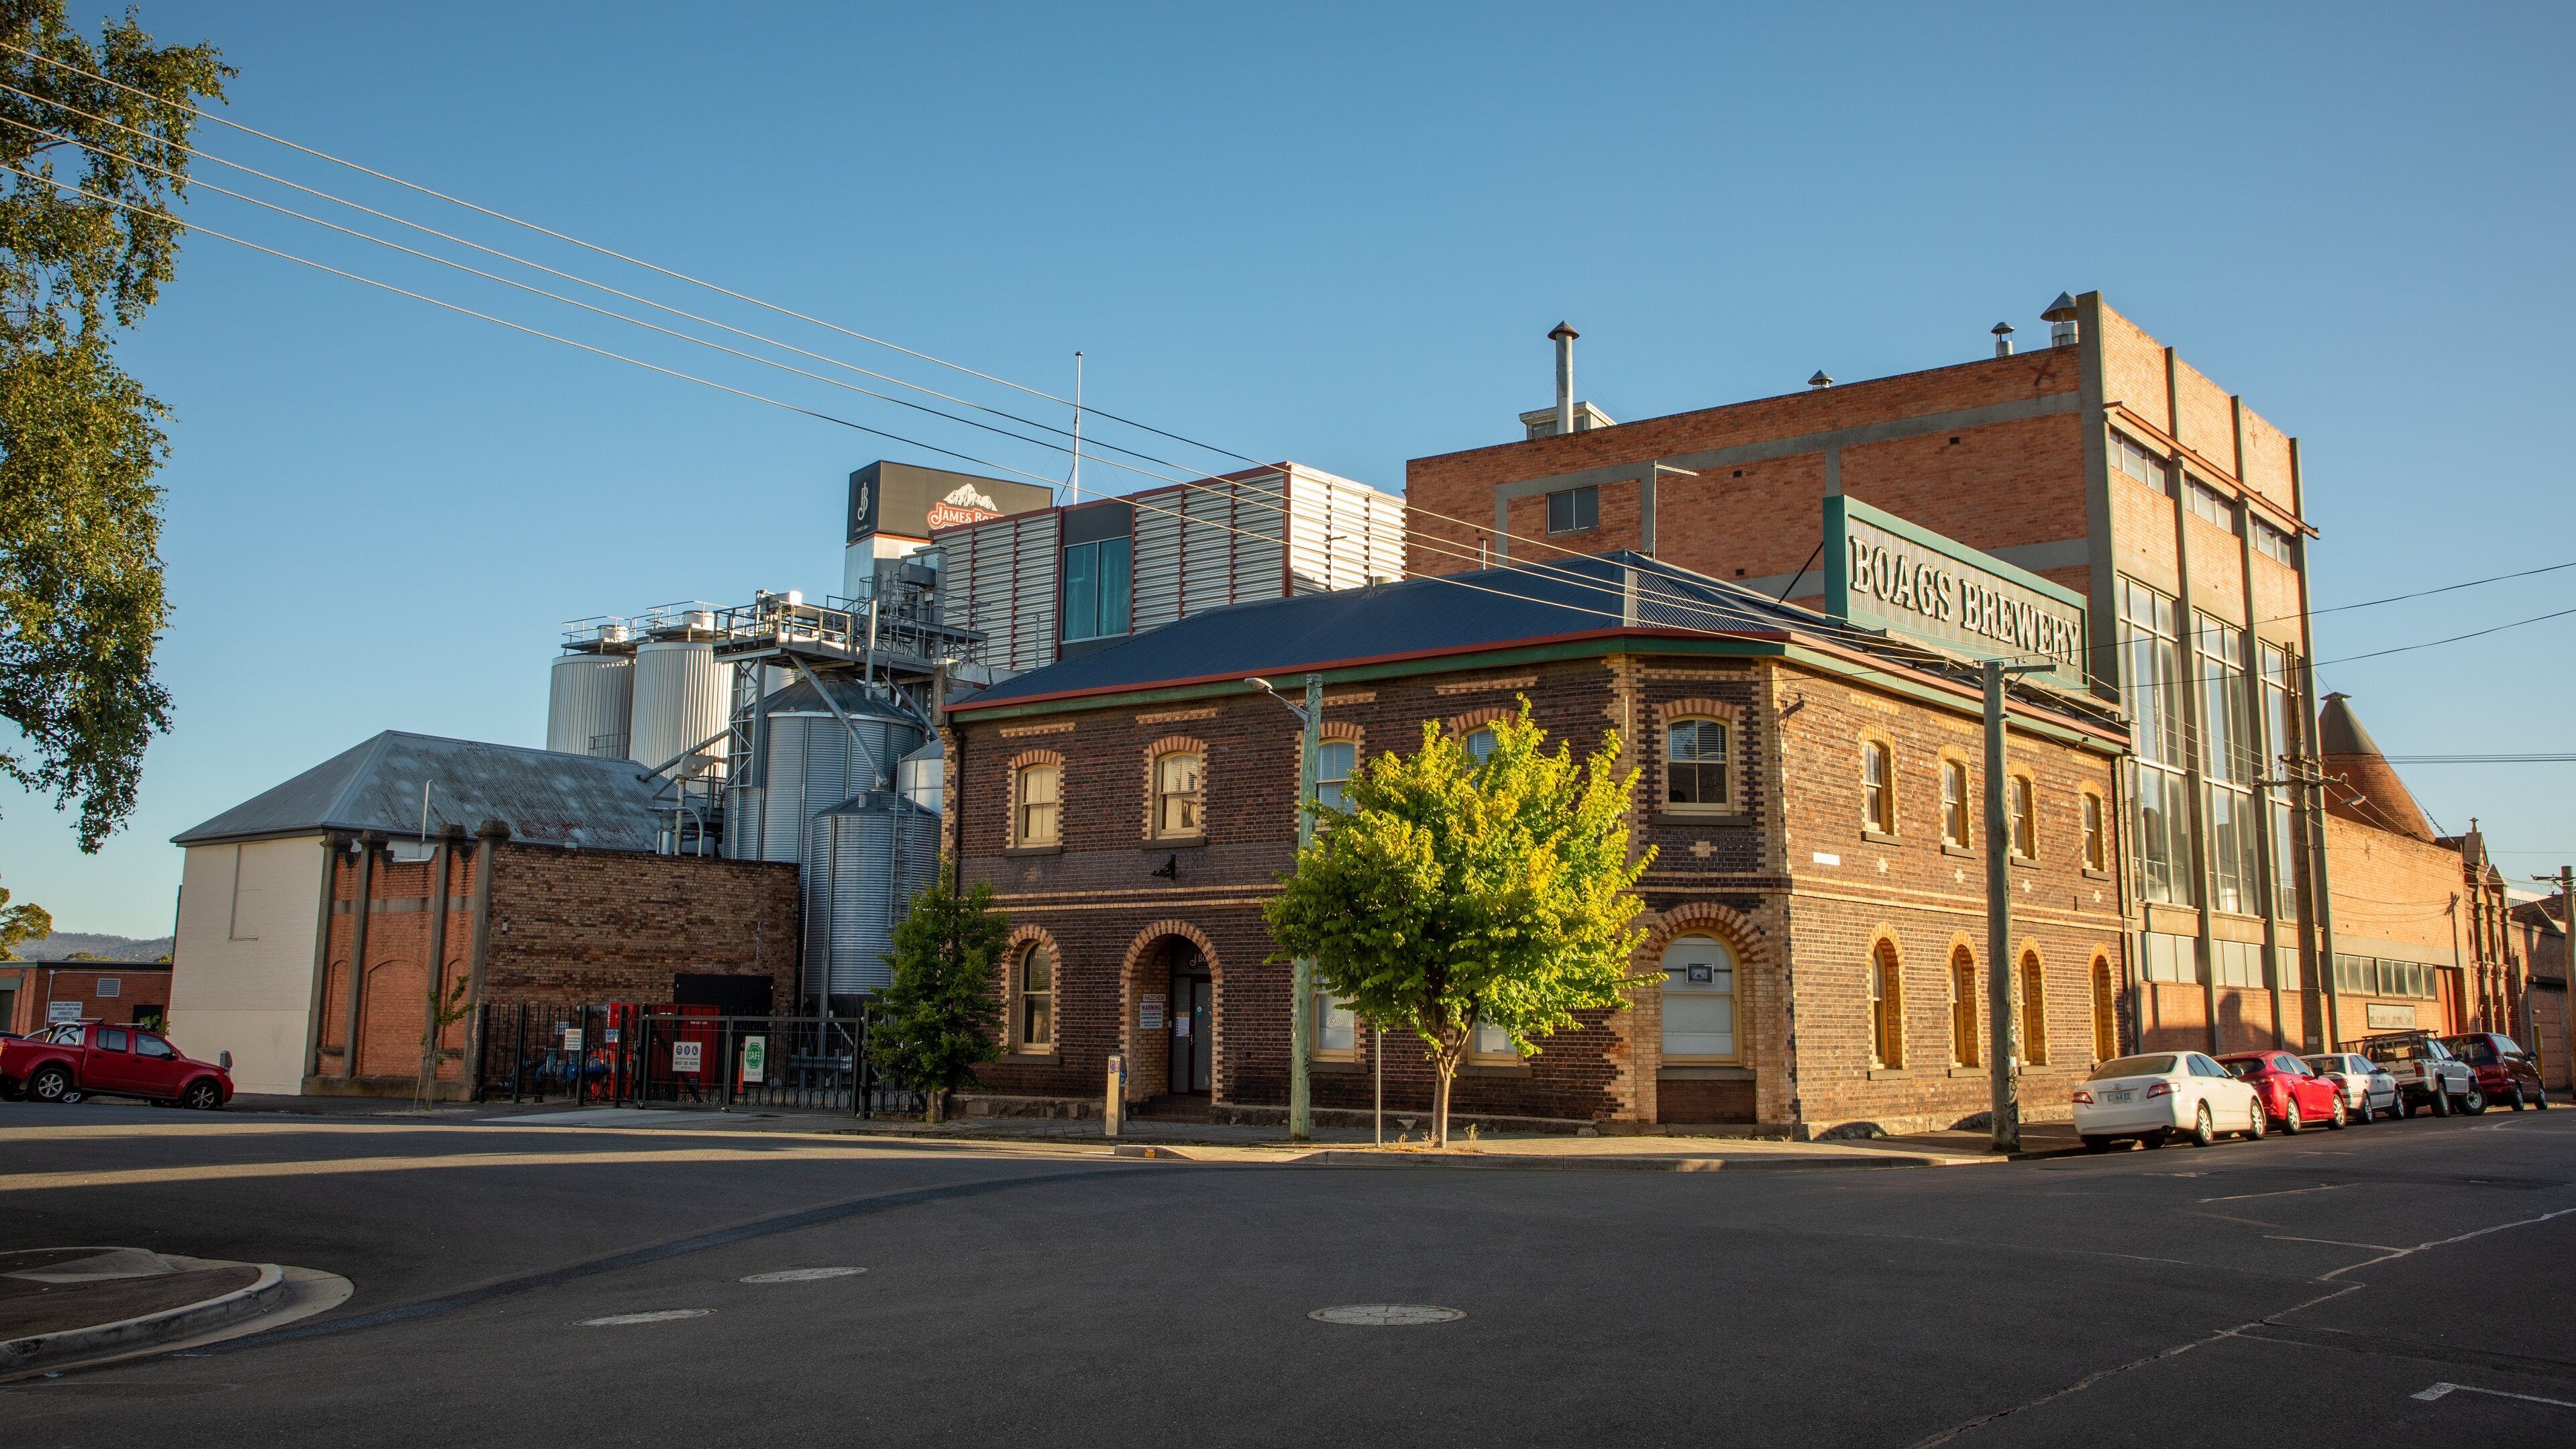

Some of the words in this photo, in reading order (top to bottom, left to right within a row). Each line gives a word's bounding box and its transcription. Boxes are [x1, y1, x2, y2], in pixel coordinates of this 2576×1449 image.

[930, 506, 971, 524] JAMES
[1849, 536, 1953, 622] BOAGS
[1960, 579, 2080, 665] BREWERY
[748, 1051, 761, 1060] SAFE
